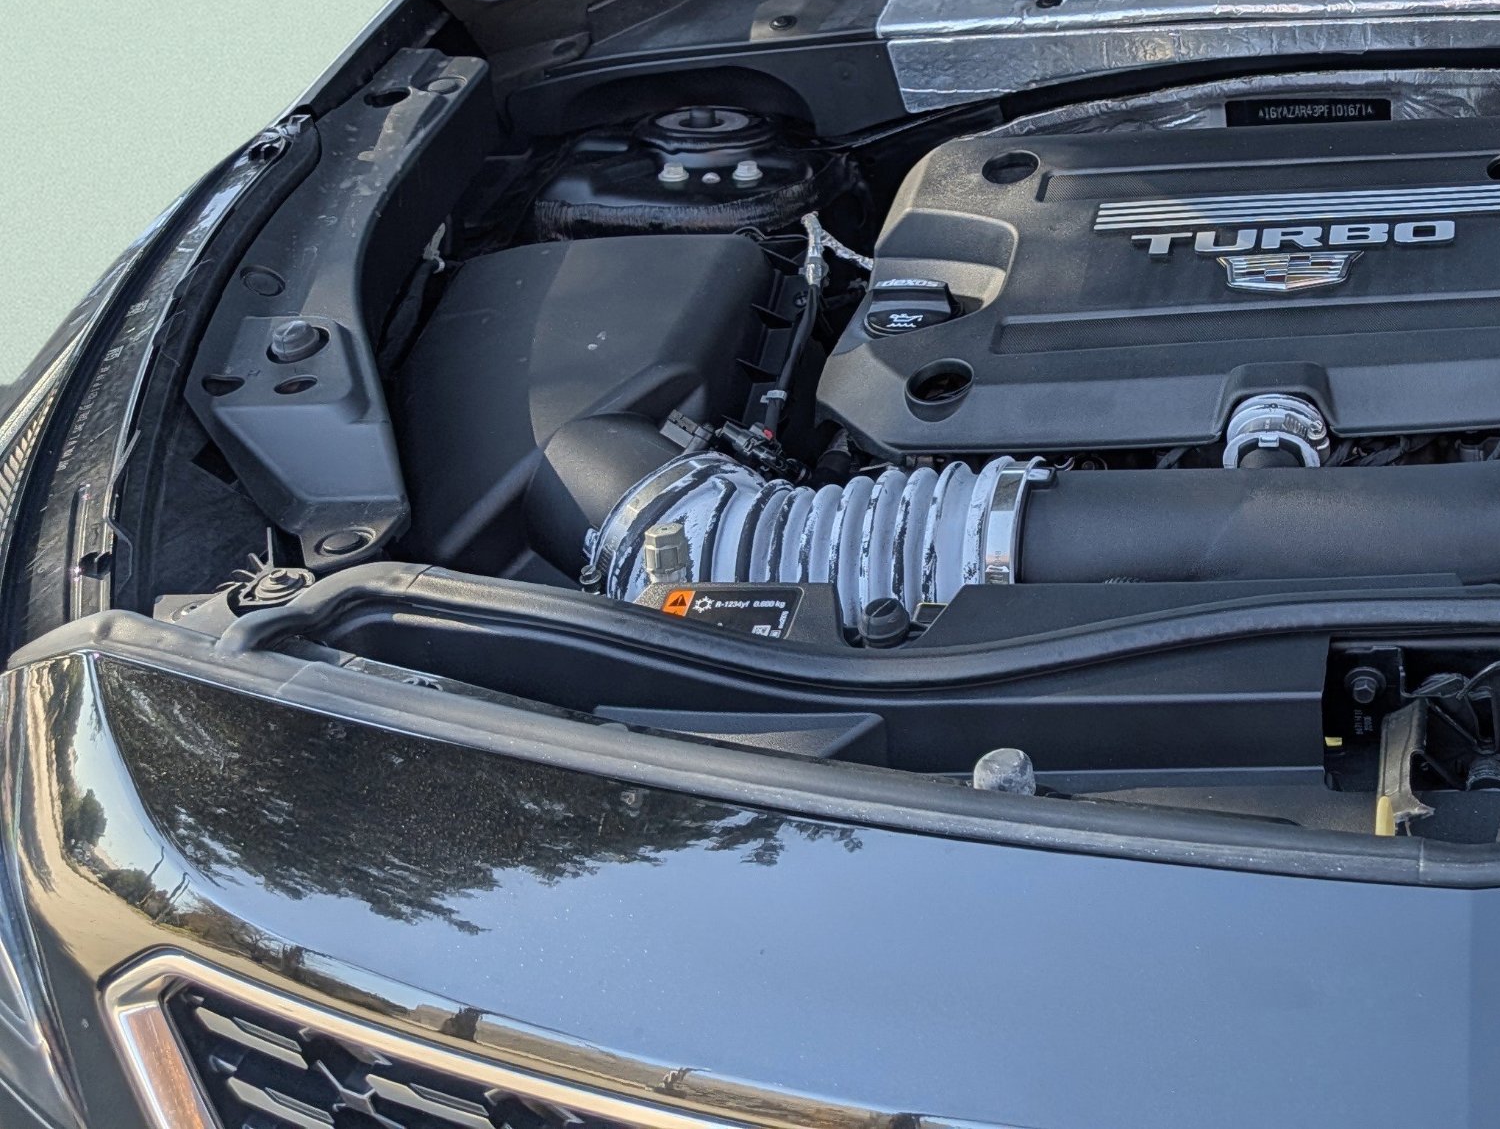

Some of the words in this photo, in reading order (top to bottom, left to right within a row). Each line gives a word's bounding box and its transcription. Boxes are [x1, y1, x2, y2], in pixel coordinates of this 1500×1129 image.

[1131, 220, 1456, 255] TURBO
[715, 600, 751, 609] R-1234yf
[775, 600, 786, 609] kg
